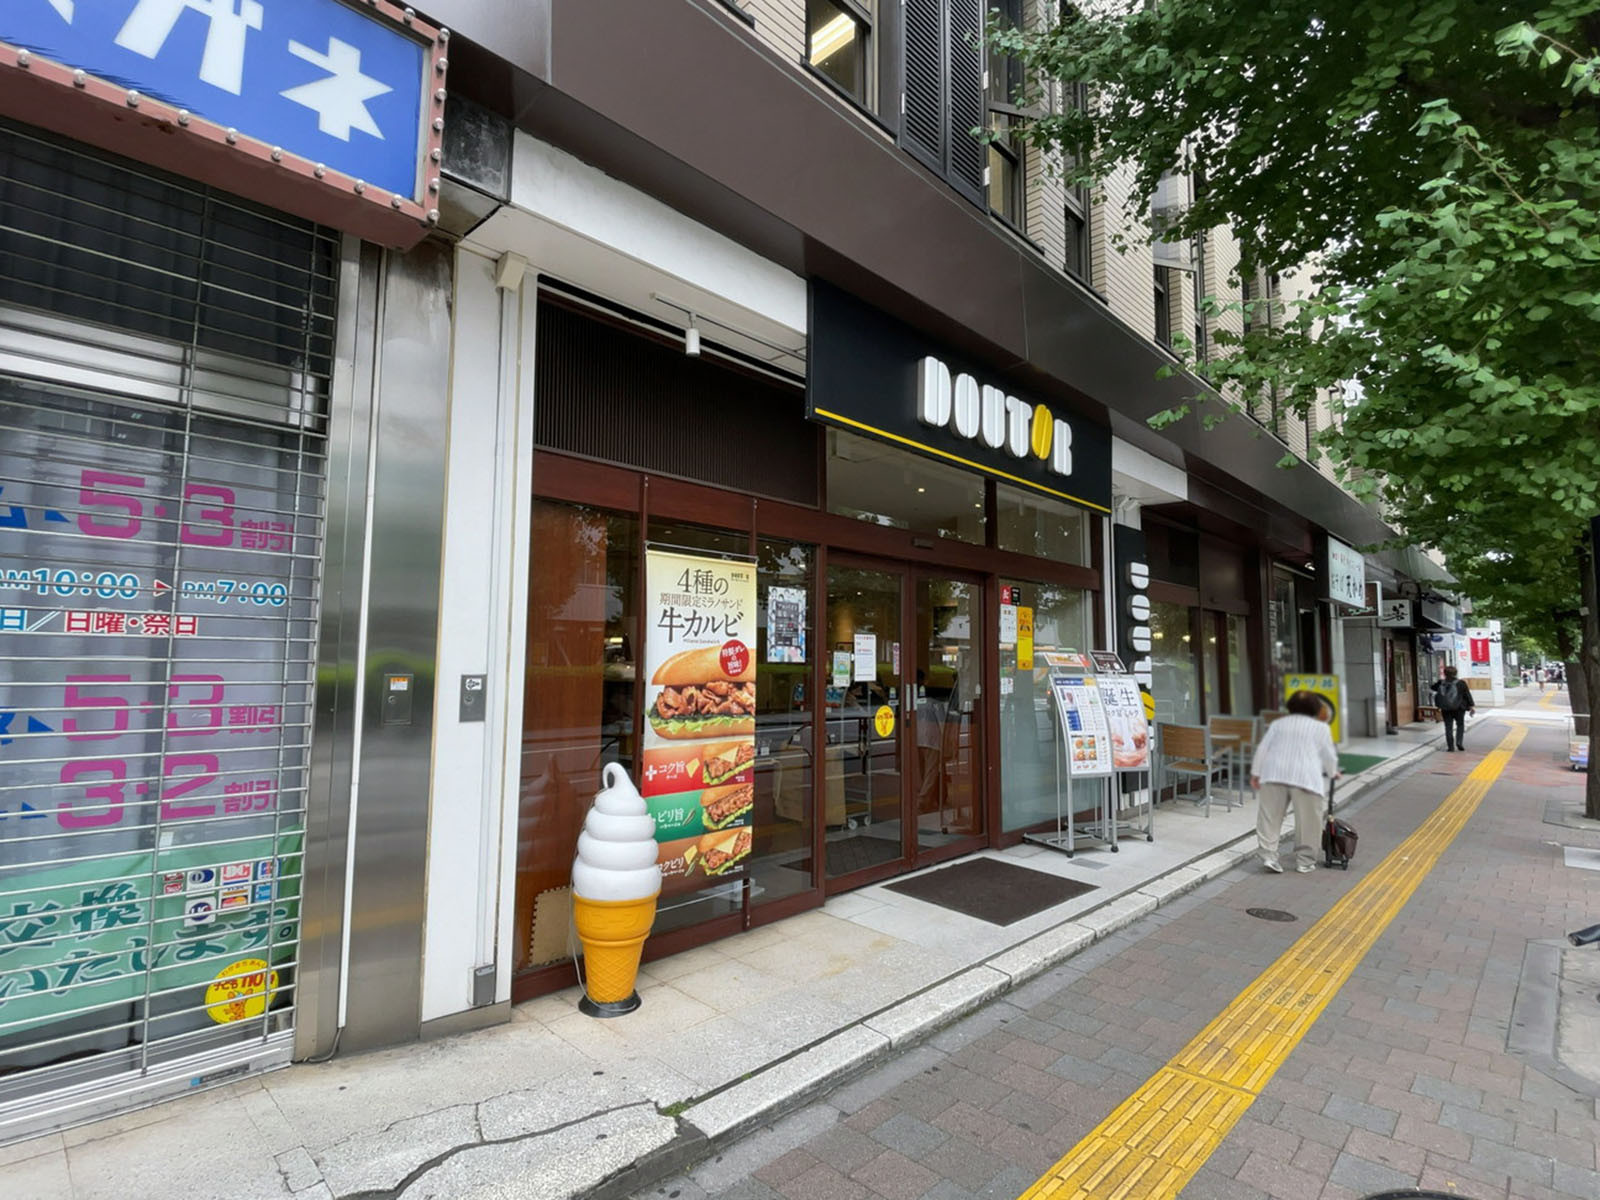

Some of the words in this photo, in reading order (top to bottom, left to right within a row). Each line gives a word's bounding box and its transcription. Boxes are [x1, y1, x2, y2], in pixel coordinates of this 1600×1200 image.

[48, 0, 393, 142] ガネ
[922, 355, 1073, 477] DOUTOR
[181, 579, 288, 607] PM7:00
[677, 567, 729, 596] 4種の
[659, 592, 743, 610] 期間限定ミラノサンド
[657, 607, 744, 643] 牛カルビ
